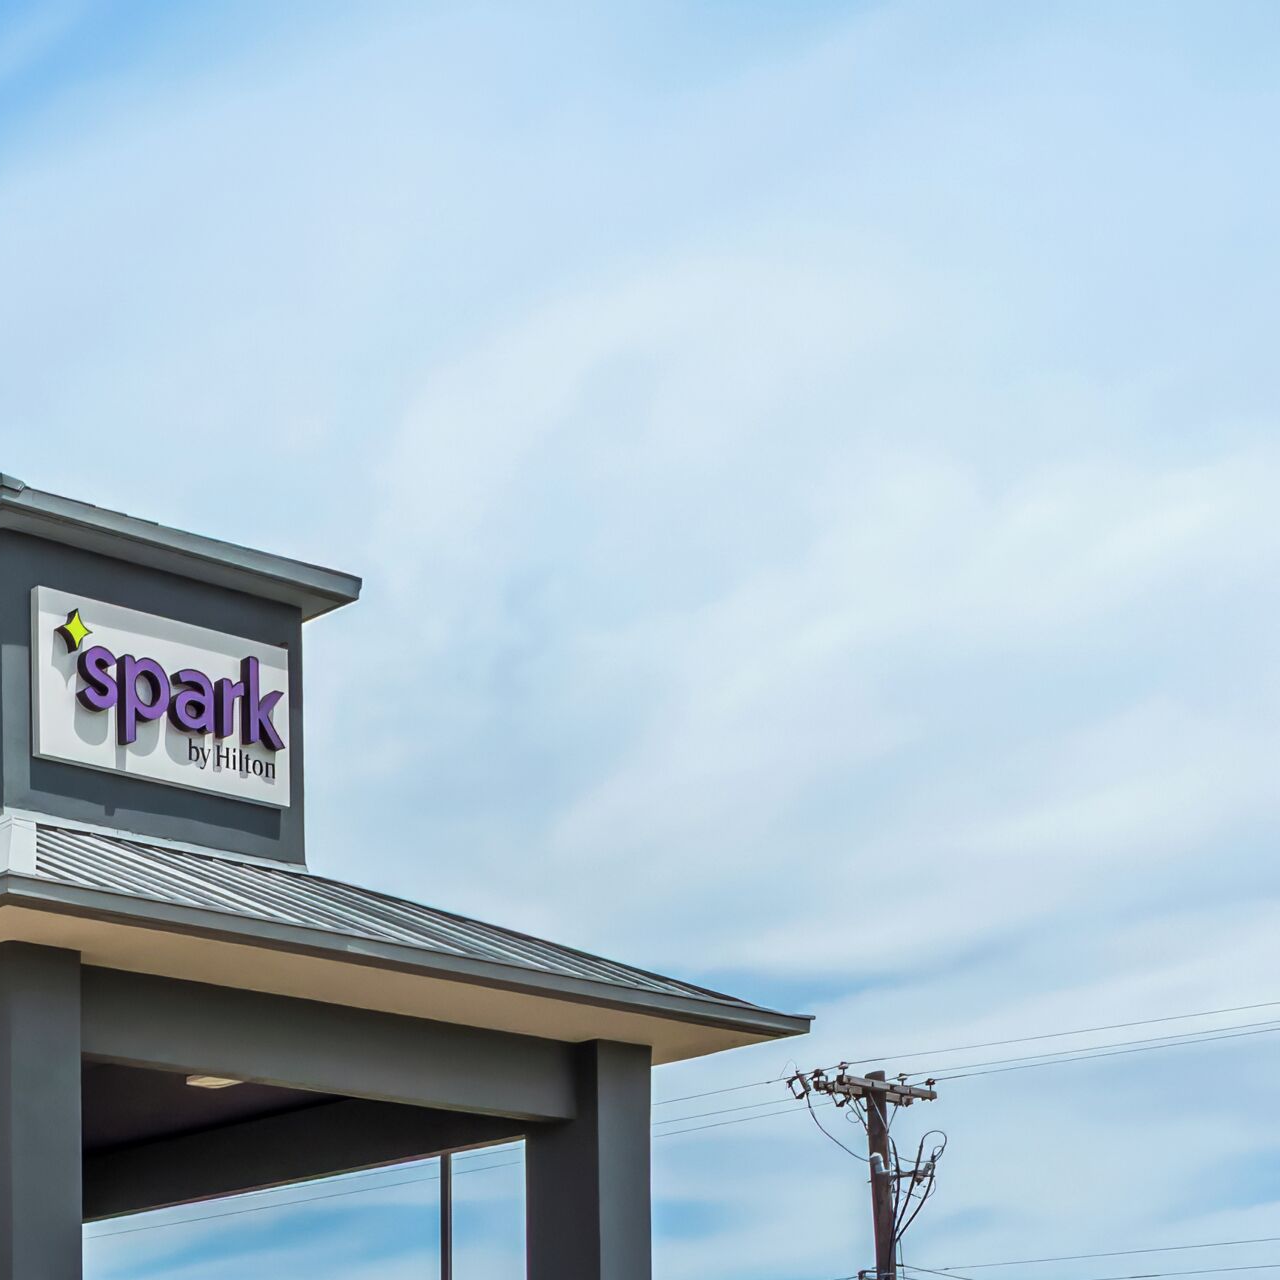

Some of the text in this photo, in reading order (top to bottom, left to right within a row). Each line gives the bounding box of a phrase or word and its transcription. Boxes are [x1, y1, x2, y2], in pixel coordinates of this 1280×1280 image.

[76, 645, 286, 752] spark
[188, 738, 276, 779] by Hilton
